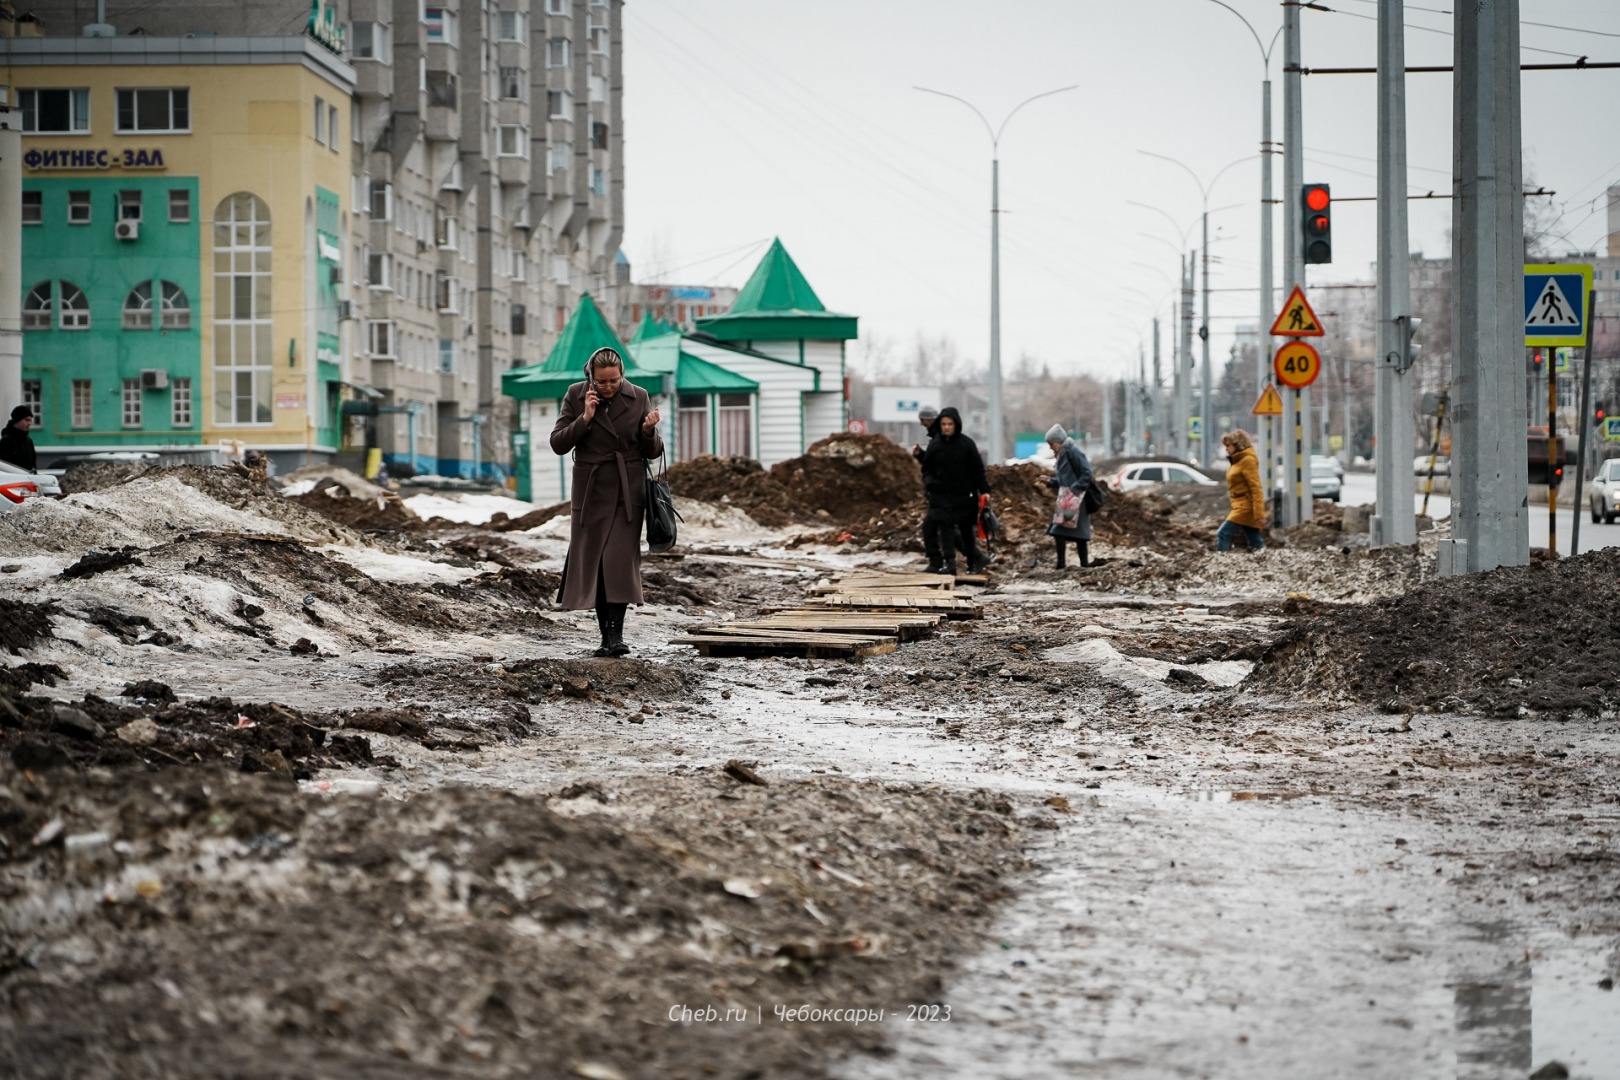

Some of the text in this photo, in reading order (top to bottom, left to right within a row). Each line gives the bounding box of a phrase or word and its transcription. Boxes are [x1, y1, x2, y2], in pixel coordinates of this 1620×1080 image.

[24, 149, 108, 167] ФИТНЕС
[123, 149, 164, 166] ЗАЛ
[1284, 355, 1309, 374] 40
